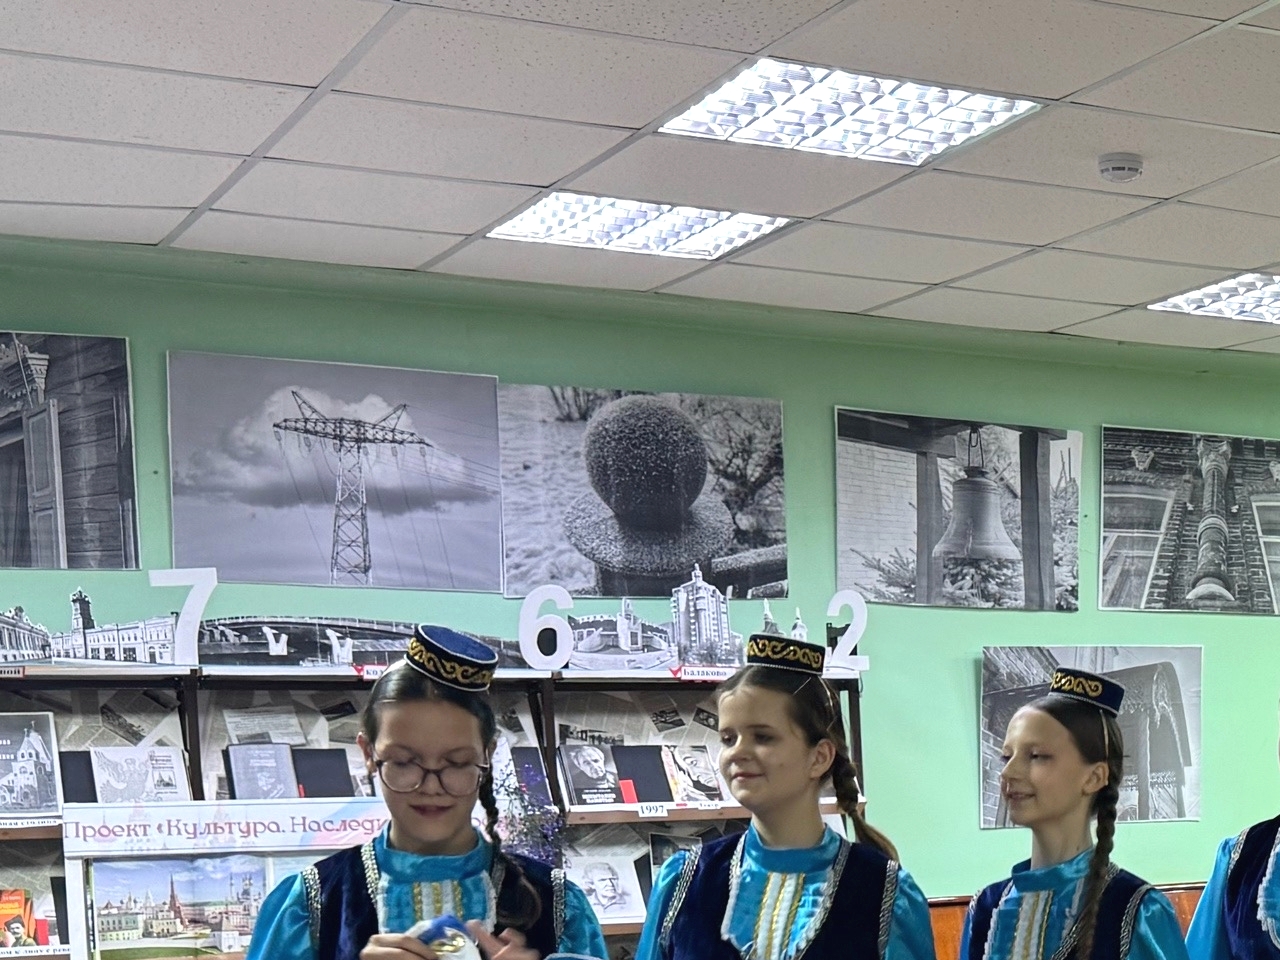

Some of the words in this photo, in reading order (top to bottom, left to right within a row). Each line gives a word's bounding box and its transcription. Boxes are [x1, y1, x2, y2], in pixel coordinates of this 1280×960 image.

[148, 567, 217, 667] 7
[518, 584, 574, 671] 6
[826, 590, 870, 671] 2
[683, 668, 727, 677] Балаково
[640, 804, 665, 814] 1997
[64, 820, 151, 843] Проект
[289, 815, 388, 836] Наследи
